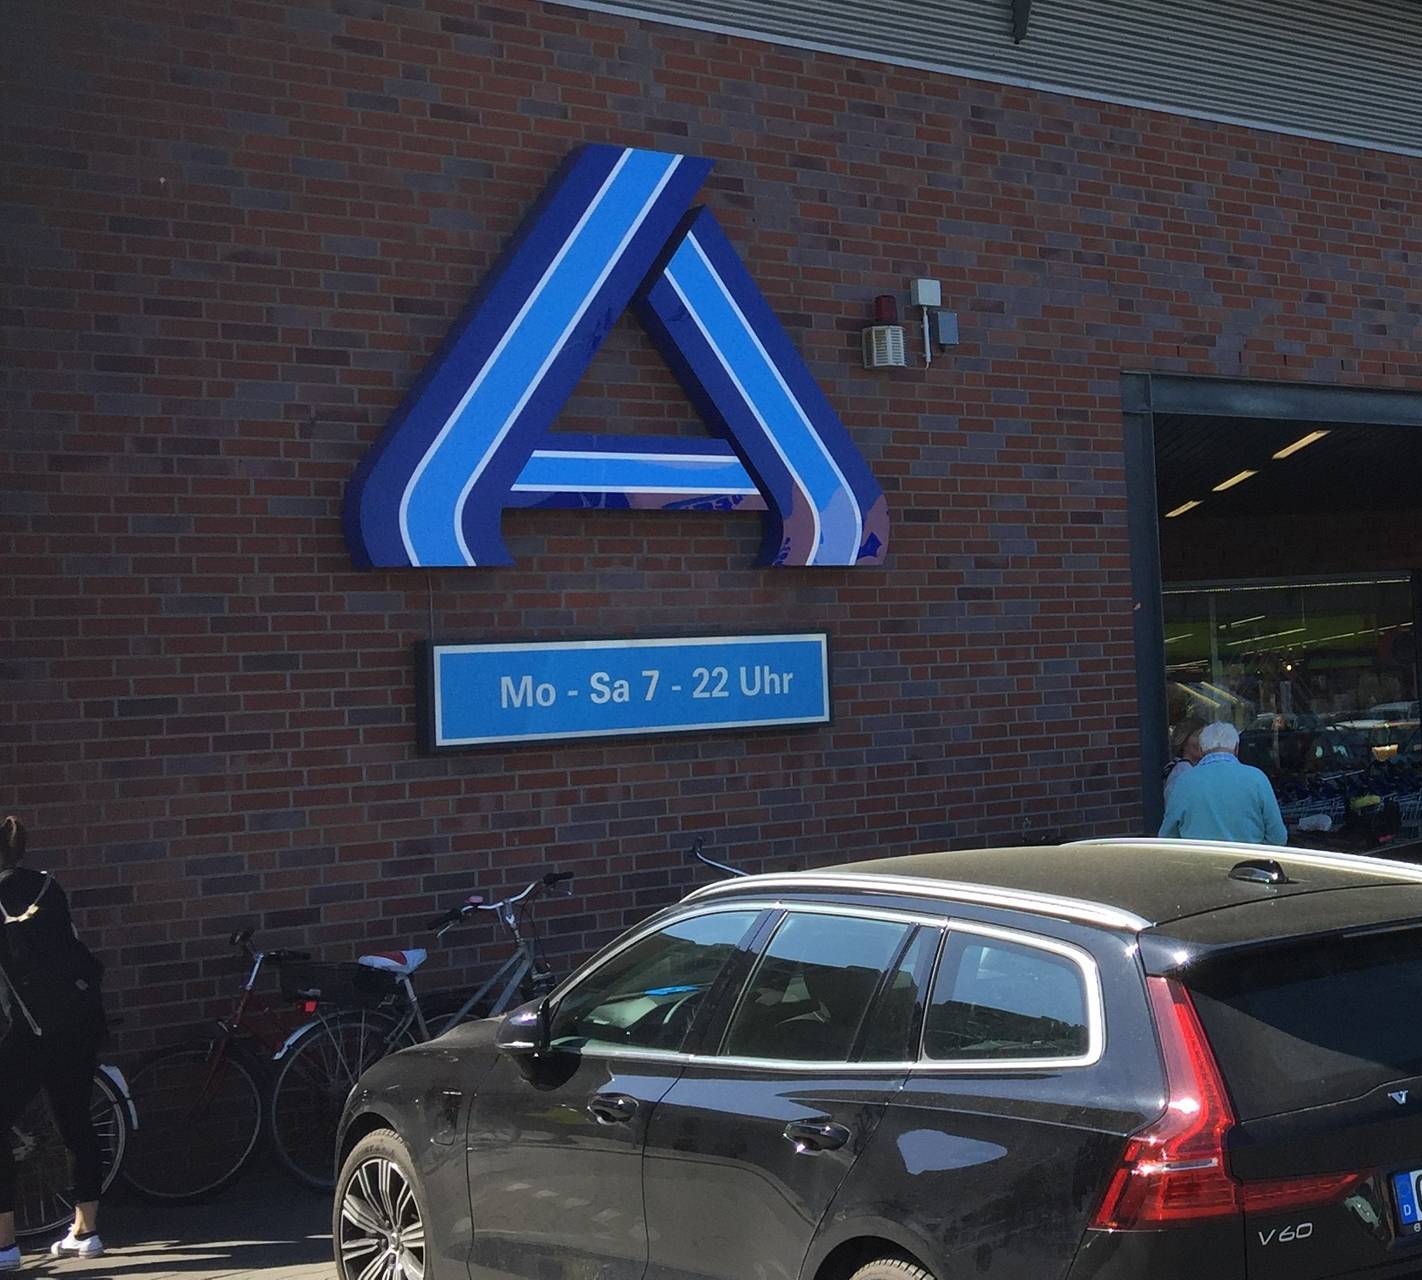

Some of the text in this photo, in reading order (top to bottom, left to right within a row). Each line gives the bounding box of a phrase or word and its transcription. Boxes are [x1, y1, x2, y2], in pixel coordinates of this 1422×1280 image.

[500, 675, 556, 709] Mo
[589, 671, 630, 704] Sa
[641, 670, 660, 701] 7
[691, 666, 729, 698] 22
[739, 665, 793, 697] Uhr
[1258, 1222, 1313, 1246] V60
